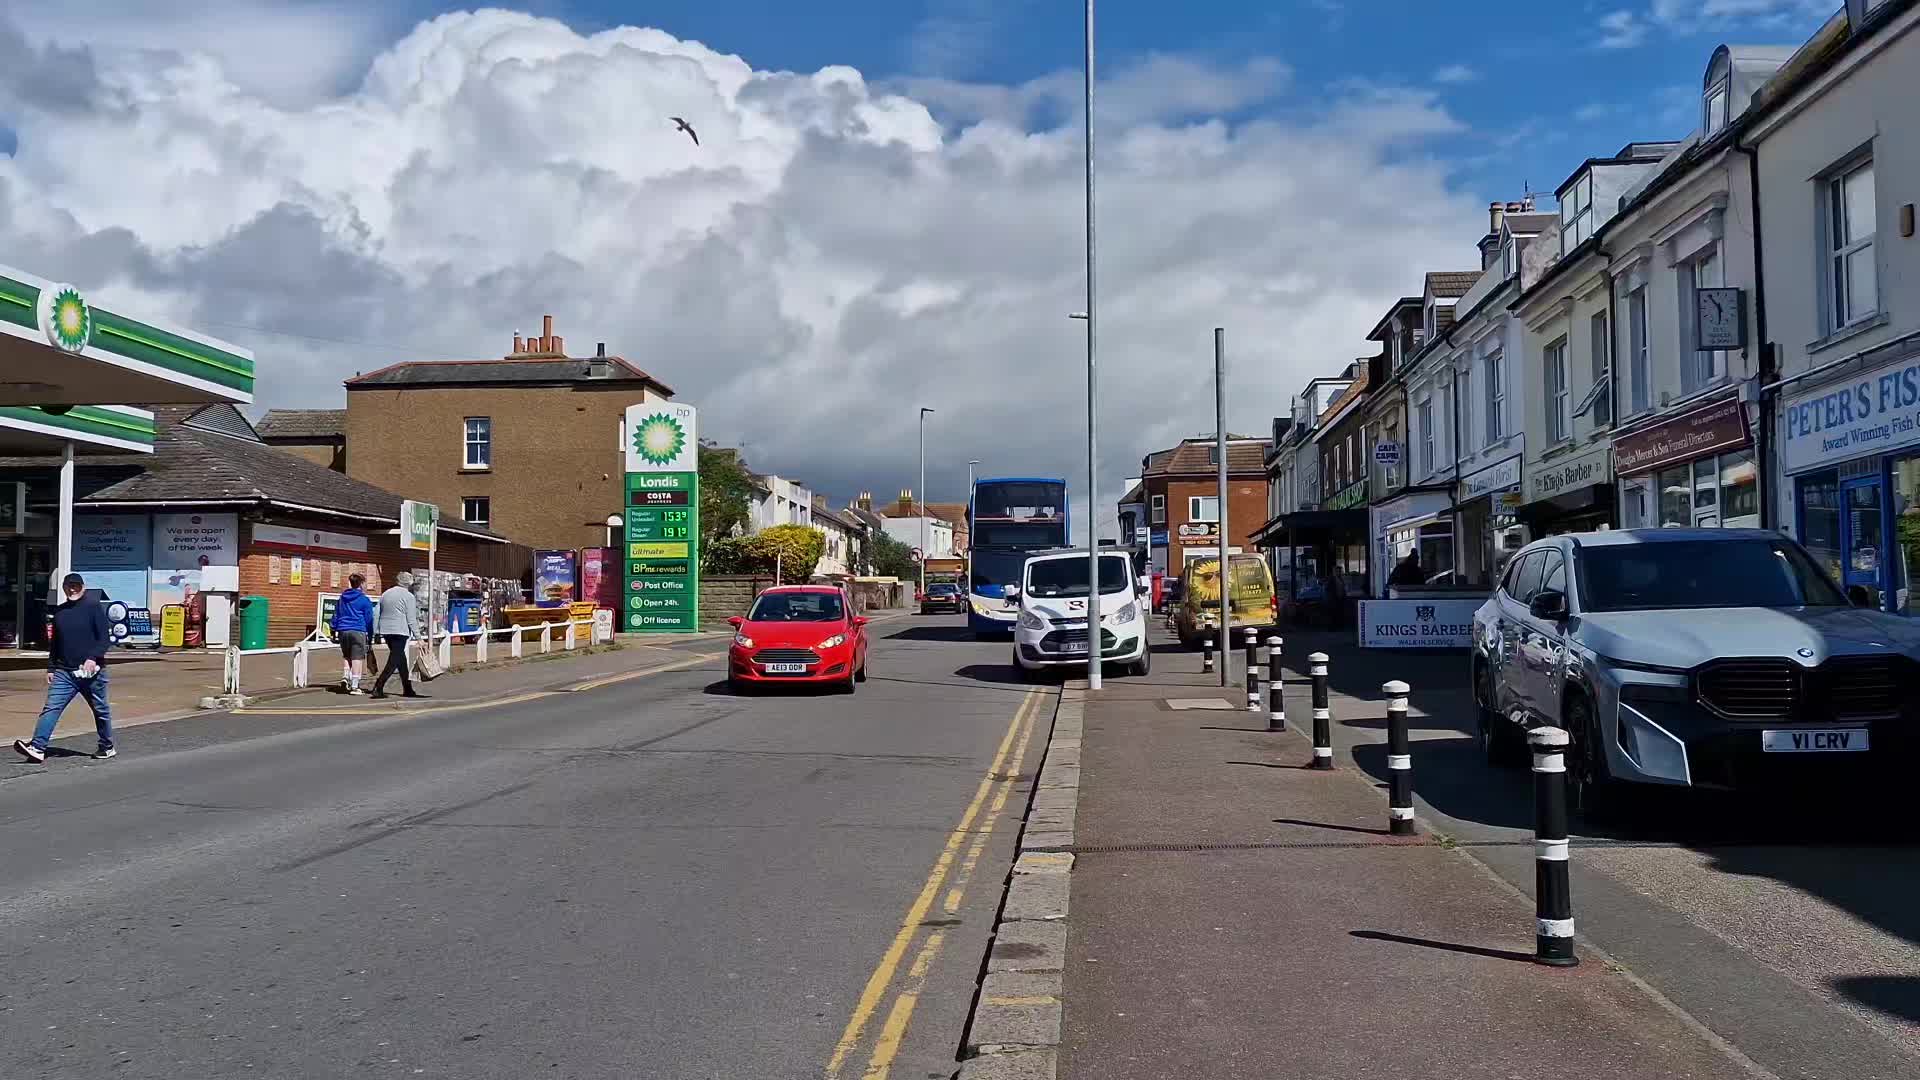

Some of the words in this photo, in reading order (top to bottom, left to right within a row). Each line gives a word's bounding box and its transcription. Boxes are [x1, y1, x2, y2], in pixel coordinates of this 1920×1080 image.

[1787, 381, 1871, 440] PETER'S
[1878, 365, 1920, 413] FIS
[677, 408, 690, 418] bp
[1822, 432, 1848, 452] Award
[1850, 424, 1890, 442] Winning
[1892, 415, 1913, 434] Fish
[1565, 463, 1592, 485] Barber
[640, 476, 679, 488] Londis
[647, 492, 672, 500] COSTA
[201, 528, 225, 536] open
[201, 536, 218, 544] day
[168, 544, 178, 552] of
[644, 581, 660, 589] Post
[662, 581, 684, 589] Office
[643, 599, 663, 607] Open
[128, 611, 150, 619] FREE
[643, 616, 655, 624] Off
[1376, 624, 1417, 636] KINGS
[1814, 732, 1850, 749] CRV
